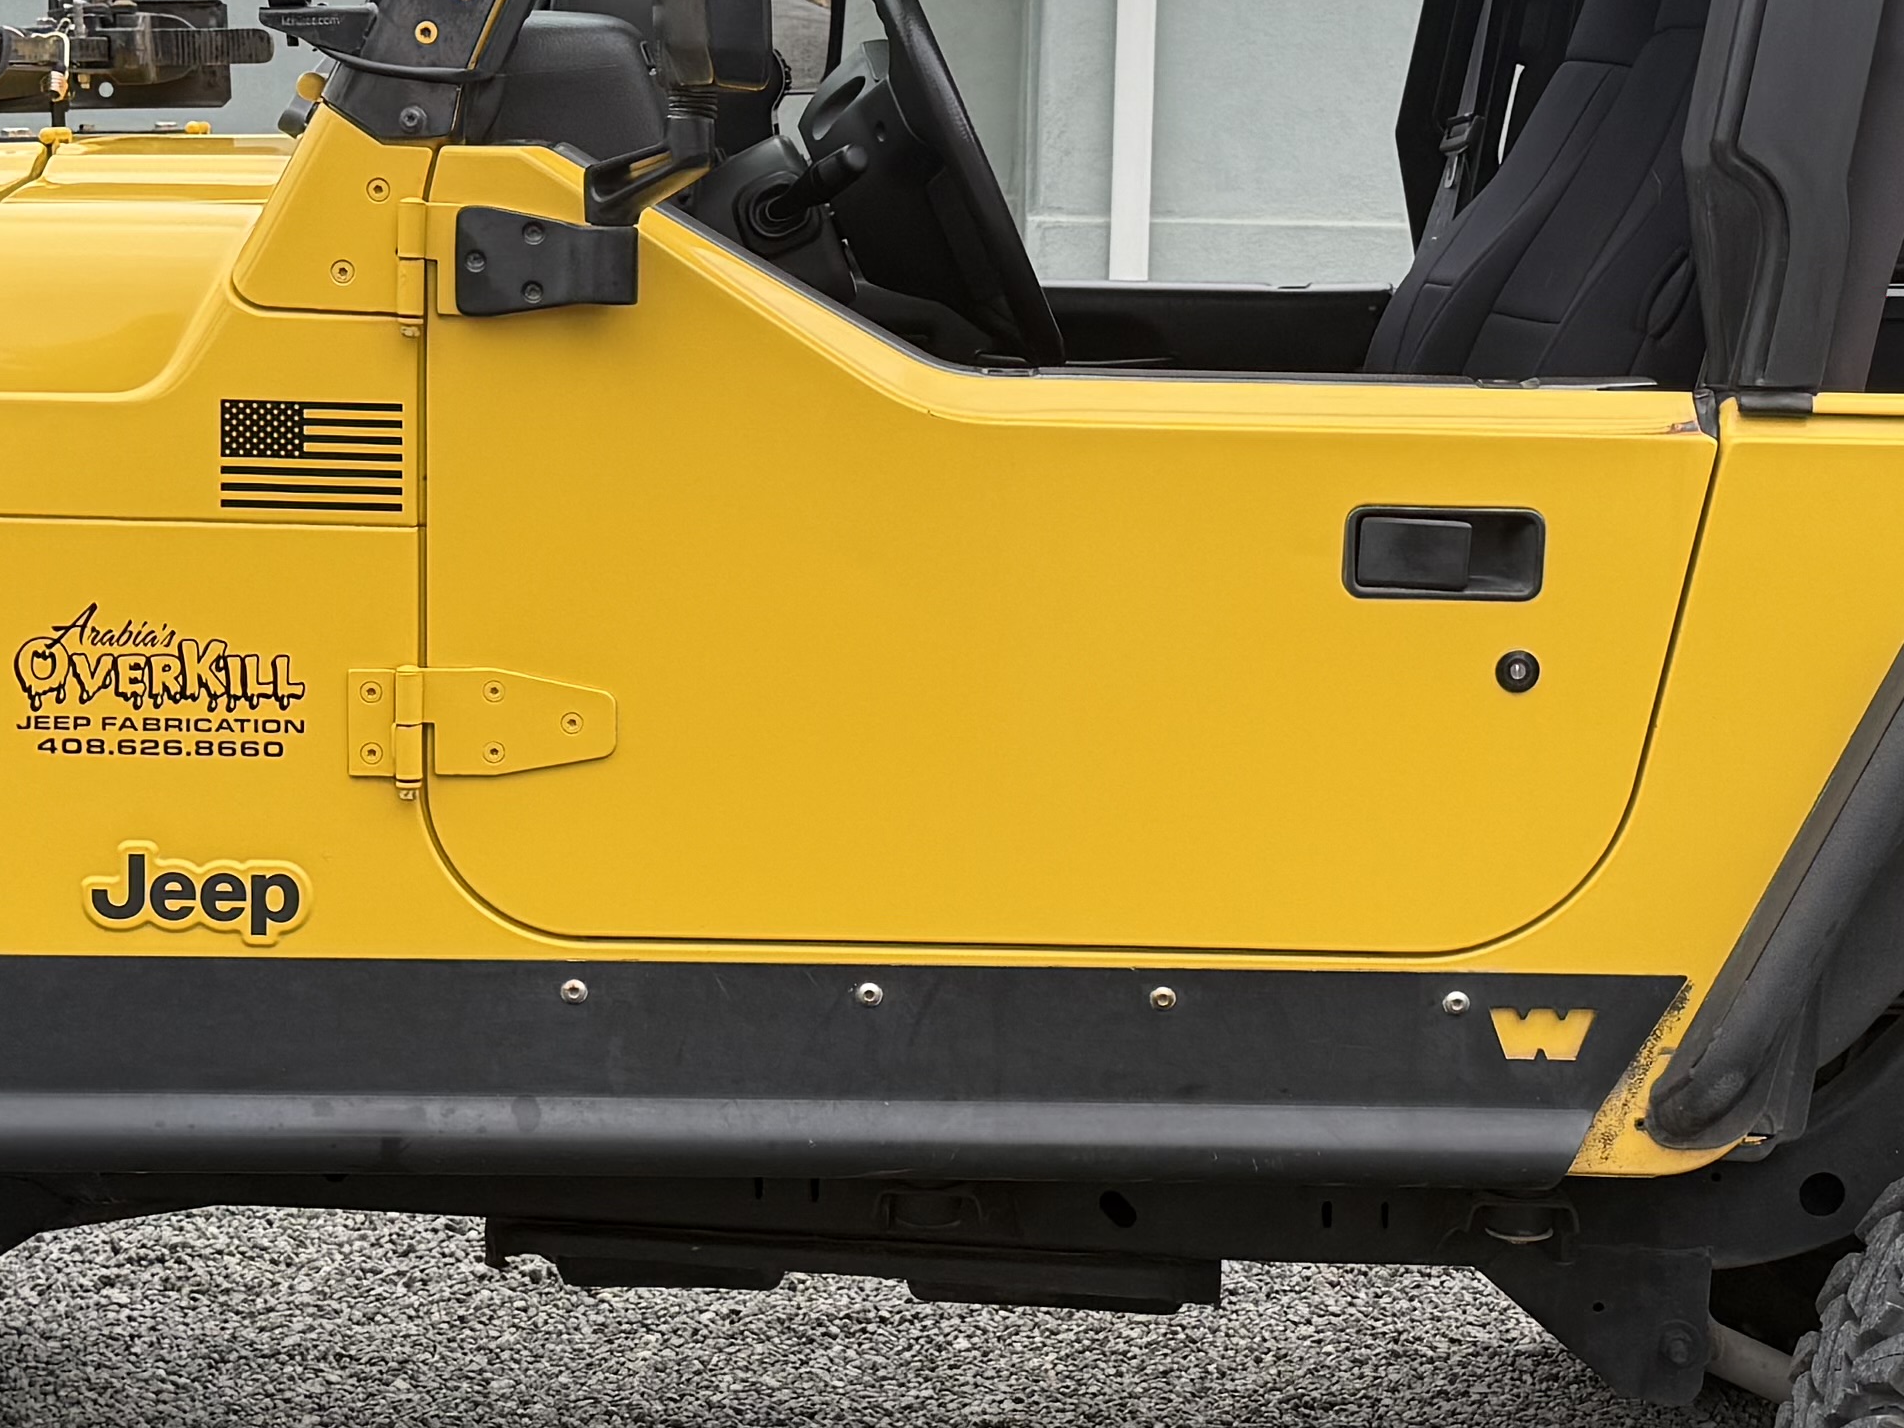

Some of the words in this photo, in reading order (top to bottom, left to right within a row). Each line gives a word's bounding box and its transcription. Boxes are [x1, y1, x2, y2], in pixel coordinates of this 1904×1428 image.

[44, 602, 176, 649] Arabia's
[16, 715, 91, 731] JEEP
[102, 716, 306, 734] FABRICATION
[37, 738, 284, 757] 408.626.8660
[91, 853, 298, 936] Jeep
